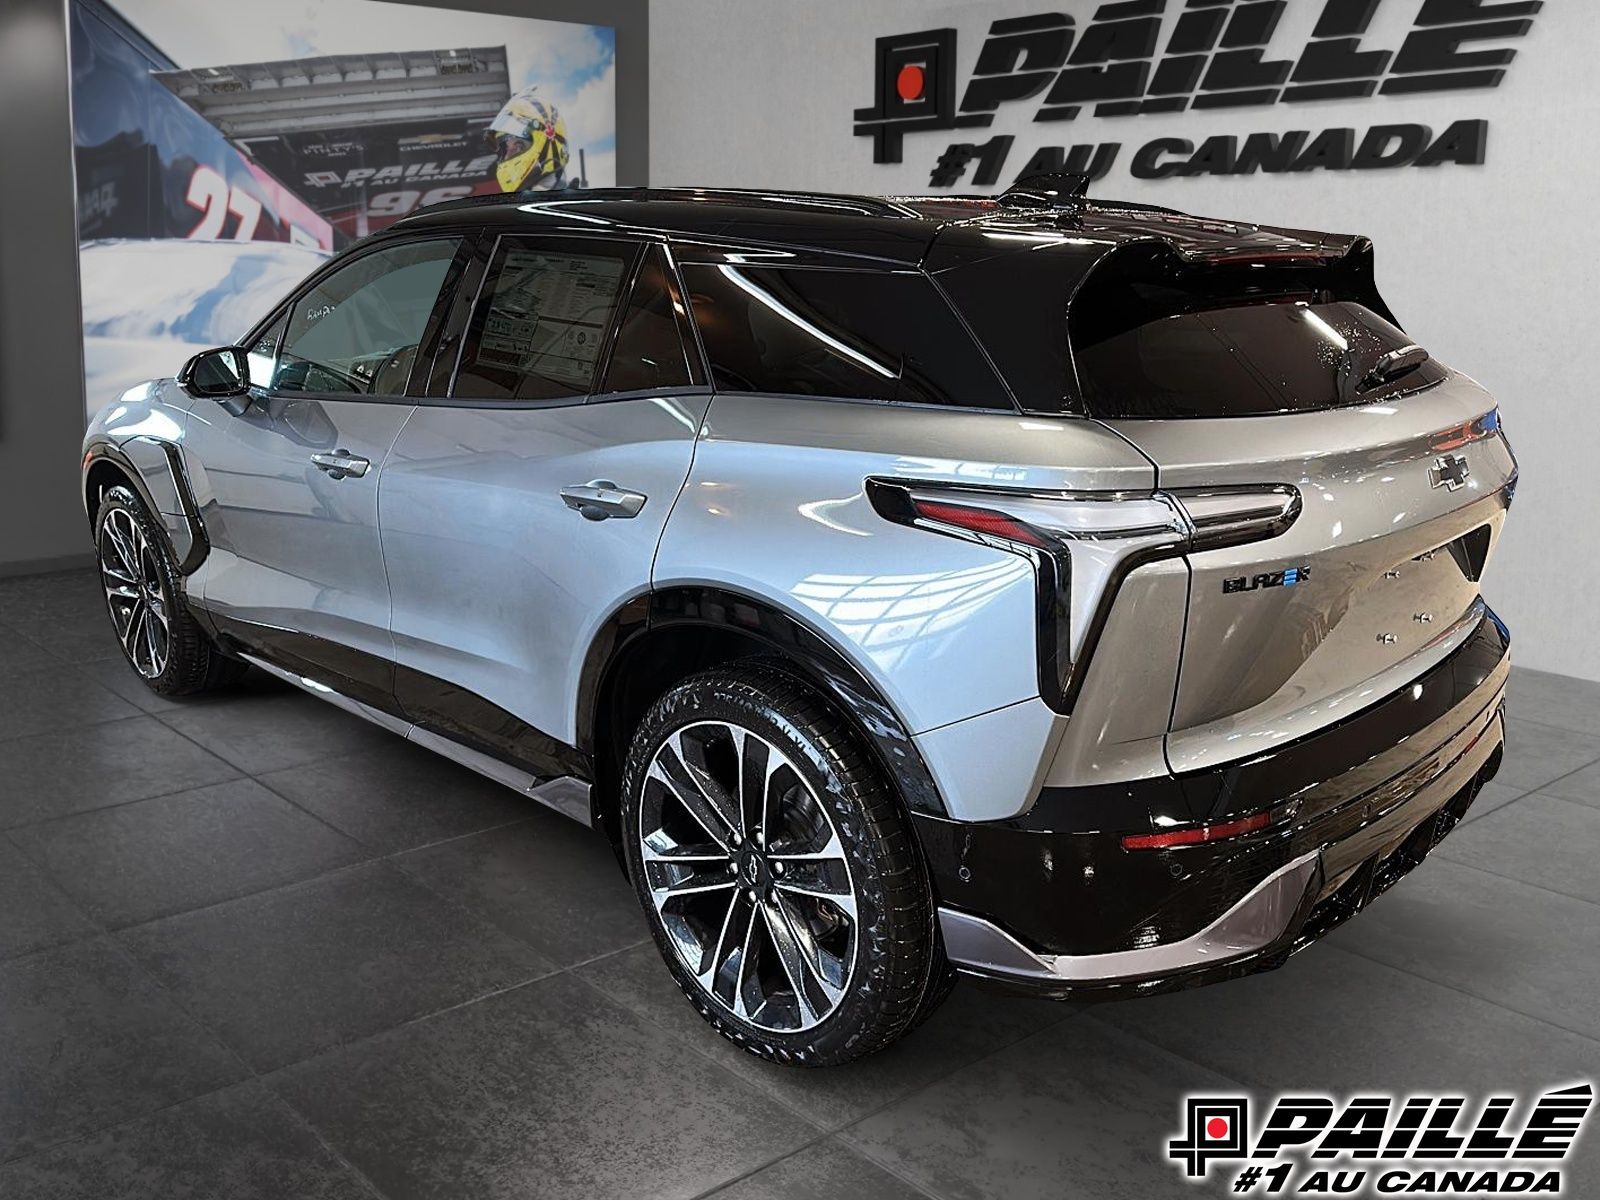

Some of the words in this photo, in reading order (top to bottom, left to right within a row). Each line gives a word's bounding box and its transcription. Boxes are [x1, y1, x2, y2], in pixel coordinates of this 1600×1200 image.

[404, 170, 487, 182] CANADA
[928, 135, 1015, 187] #1
[1012, 142, 1122, 184] AU
[1129, 118, 1489, 180] CANADA
[187, 165, 262, 242] 27
[1222, 565, 1311, 594] BLAZER
